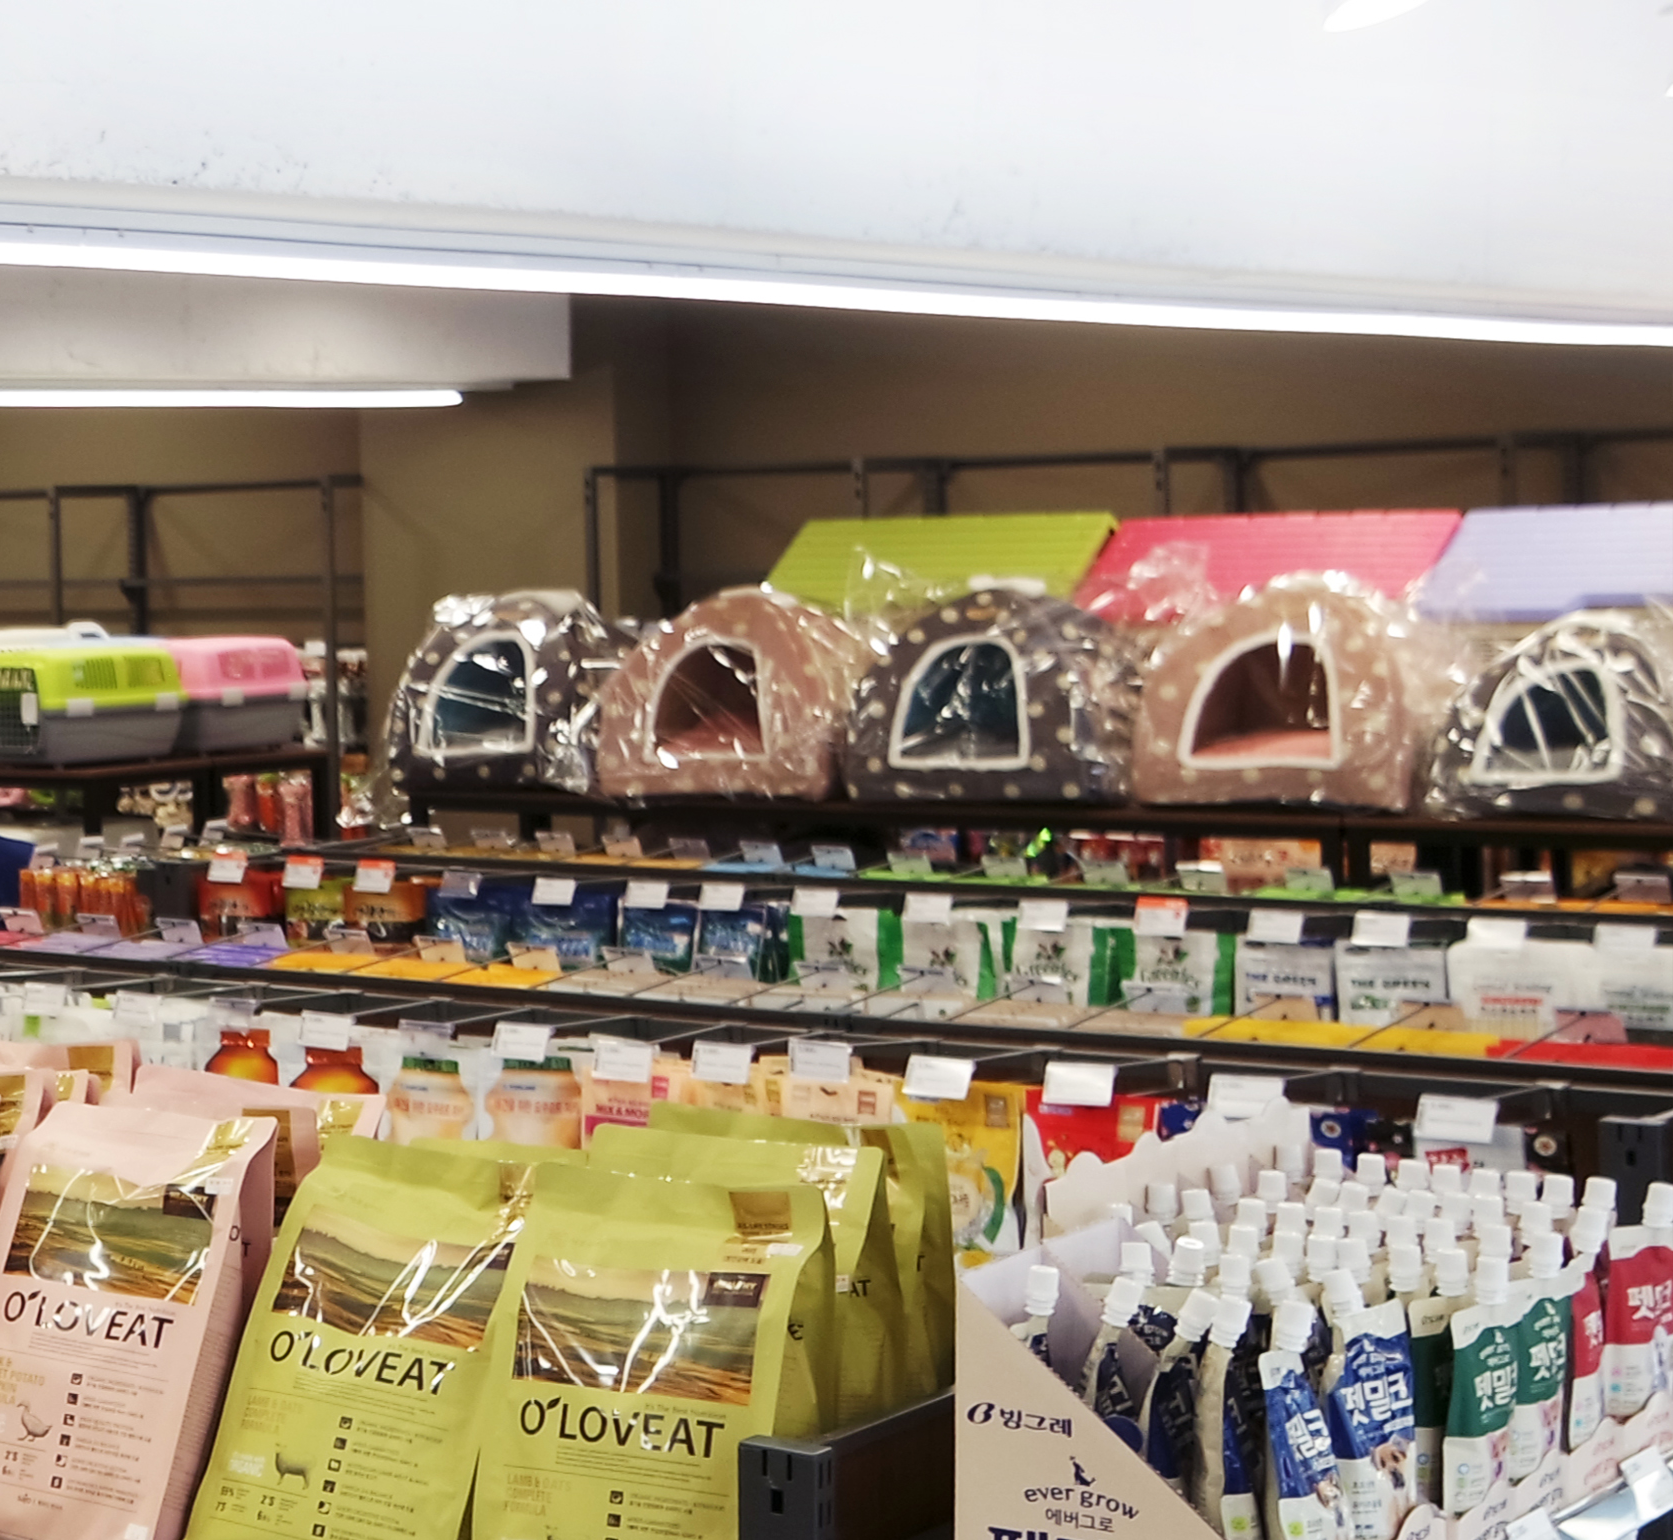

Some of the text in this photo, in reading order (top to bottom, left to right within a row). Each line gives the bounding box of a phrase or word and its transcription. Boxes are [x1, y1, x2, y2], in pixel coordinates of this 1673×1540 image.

[3, 1289, 174, 1349] O'LOVEAT
[269, 1330, 455, 1396] O'LOVEAT
[520, 1397, 725, 1459] O'LOVEAT
[999, 1407, 1072, 1438] 빙그레
[1024, 1485, 1140, 1520] ever grow
[1045, 1508, 1115, 1533] 에버그로
